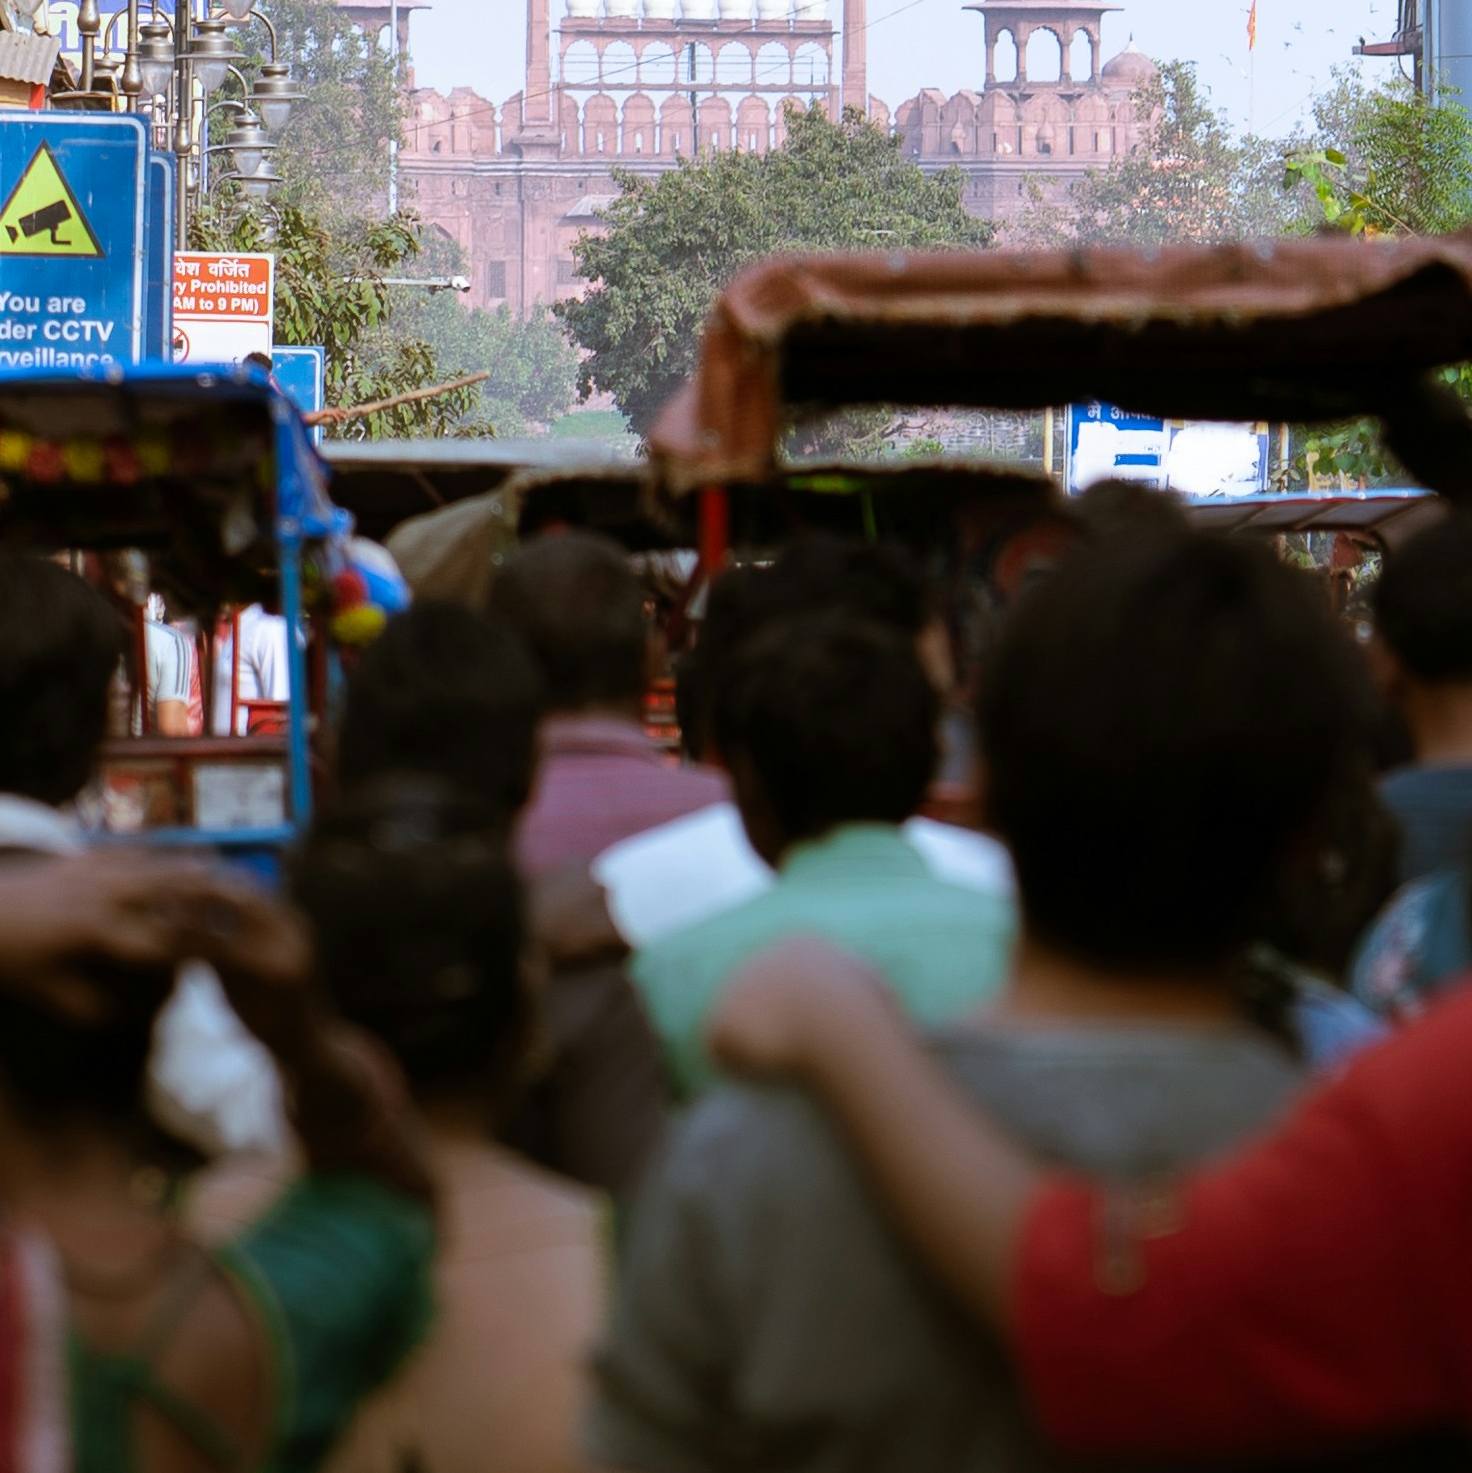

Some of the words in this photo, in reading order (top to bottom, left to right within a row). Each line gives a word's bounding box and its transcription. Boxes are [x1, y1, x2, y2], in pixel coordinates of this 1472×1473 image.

[208, 258, 251, 278] वर्जित
[190, 279, 267, 295] Prohibited
[47, 296, 87, 314] are
[199, 298, 214, 311] to
[217, 297, 227, 311] 9
[231, 298, 259, 314] PM)
[43, 320, 115, 342] CCTV
